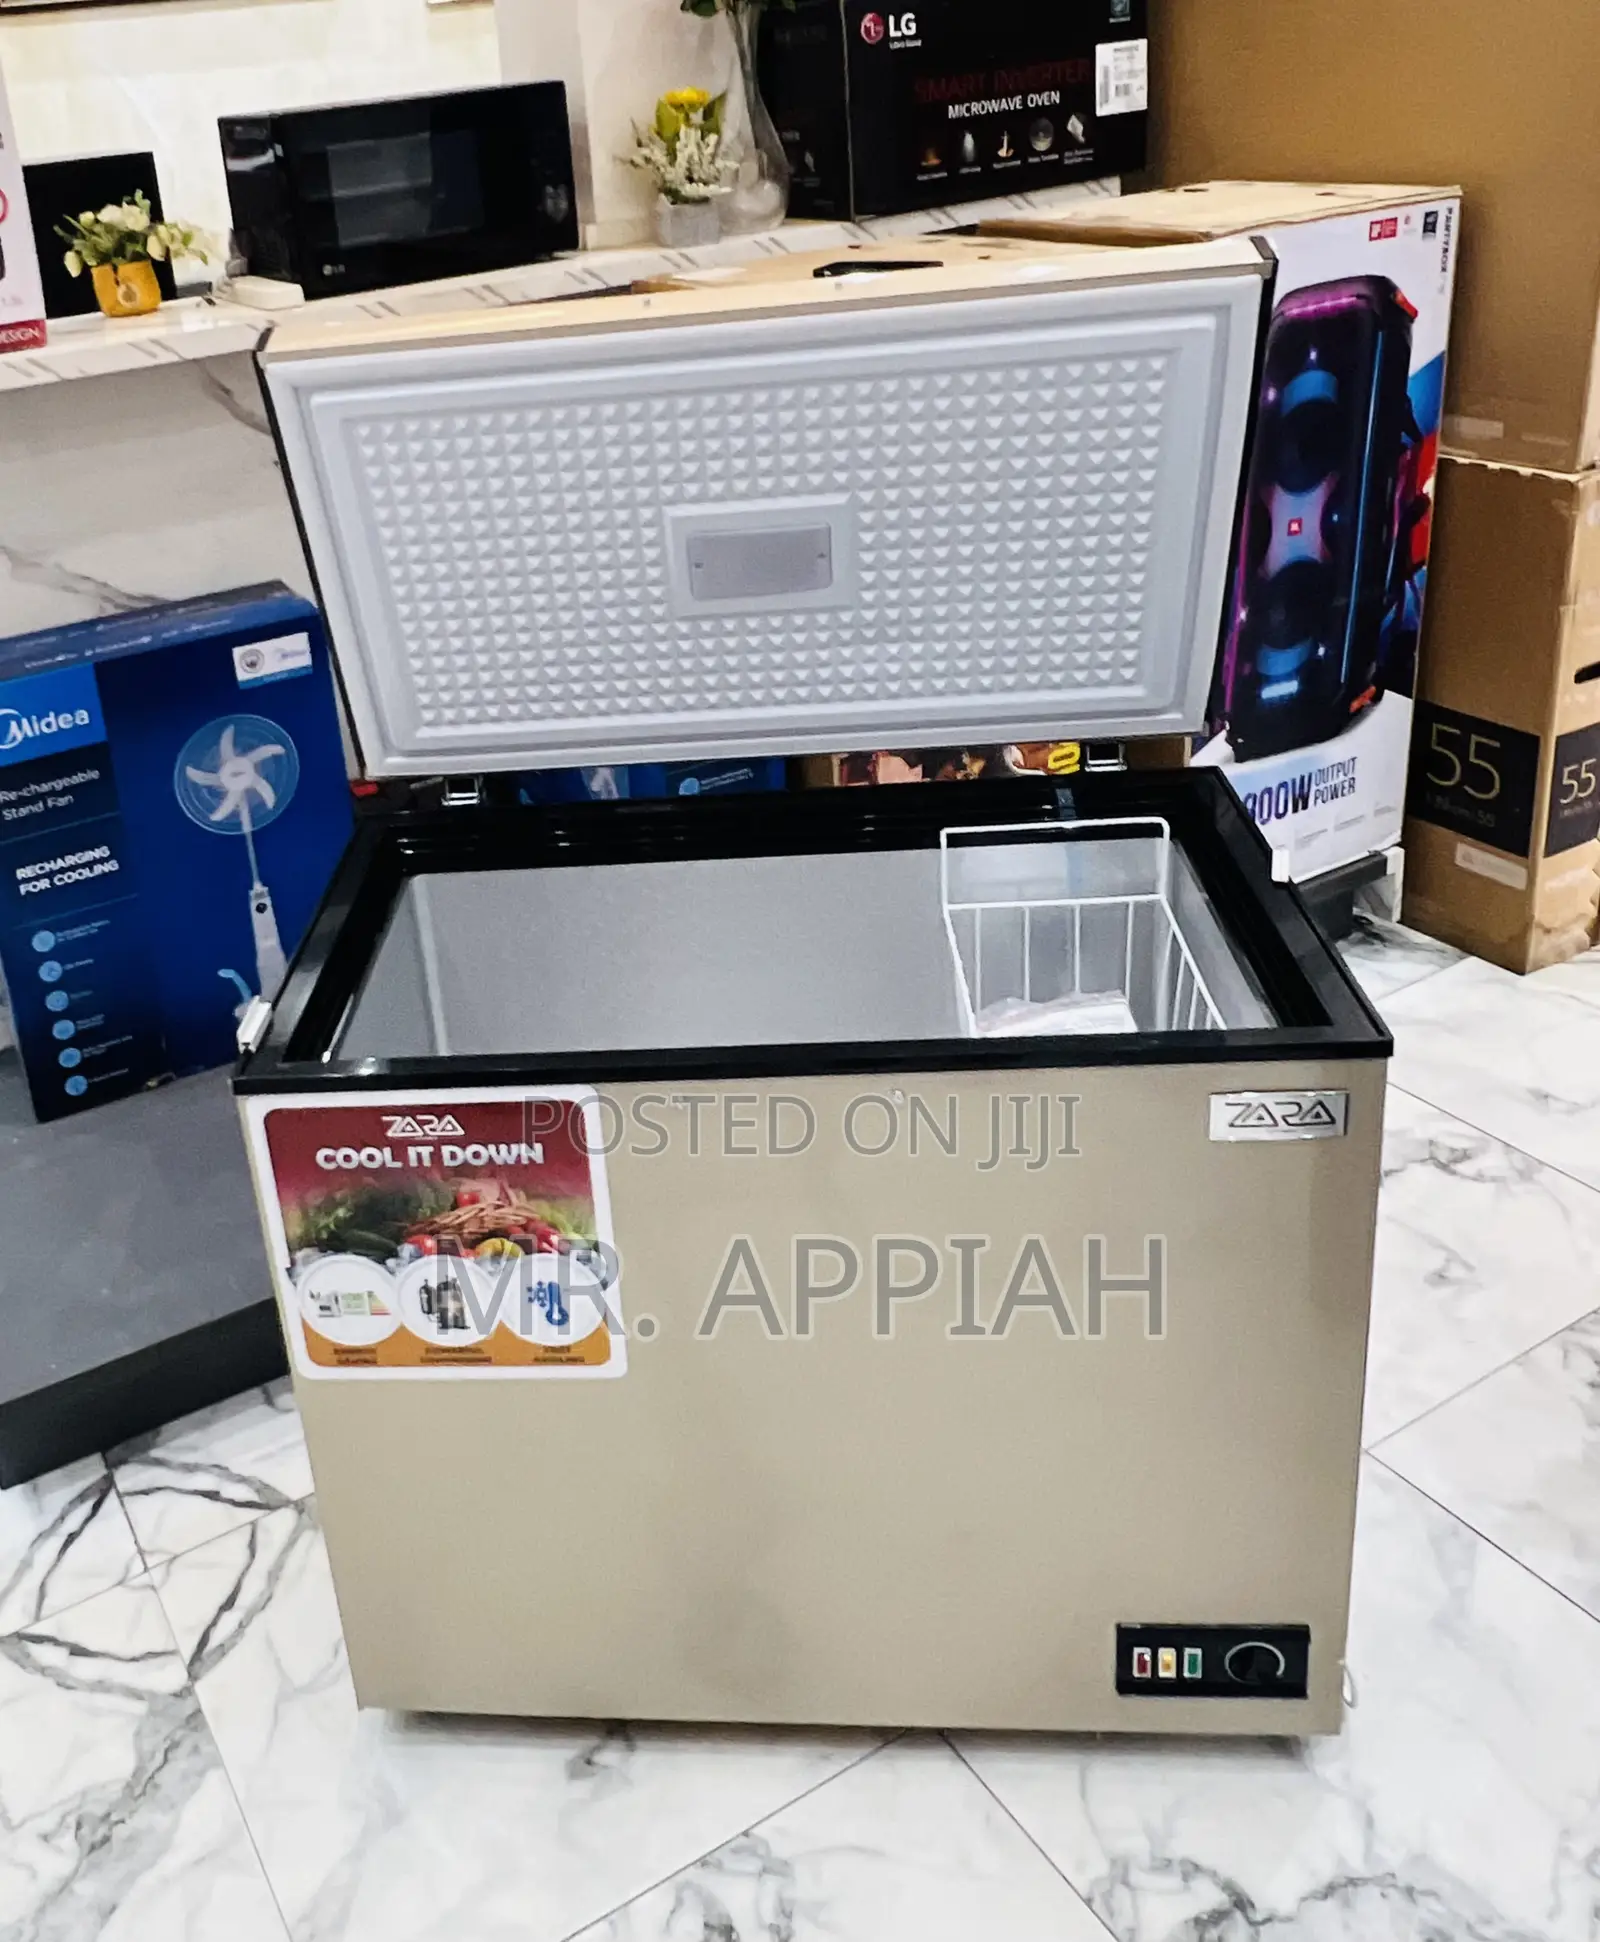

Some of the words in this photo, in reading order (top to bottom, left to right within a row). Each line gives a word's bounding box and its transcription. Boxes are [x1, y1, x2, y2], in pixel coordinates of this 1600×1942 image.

[889, 12, 917, 38] LG
[914, 71, 987, 103] SMART
[948, 94, 1023, 120] MICROWAVE
[1027, 89, 1061, 108] OVEN
[4, 708, 90, 744] Midea
[1314, 756, 1358, 786] OUTPUT
[1426, 722, 1501, 800] 55
[1314, 777, 1357, 807] POWER
[1559, 757, 1598, 805] 55
[2, 800, 46, 822] Stand
[47, 794, 75, 810] Fan
[16, 845, 111, 881] RECHARGING
[19, 878, 51, 896] FOR
[53, 859, 120, 887] COOLING
[380, 1113, 466, 1138] ZARA
[1224, 1099, 1337, 1128] ZARA
[315, 1146, 403, 1171] COOL
[407, 1144, 435, 1169] IT
[440, 1142, 545, 1168] DOWN
